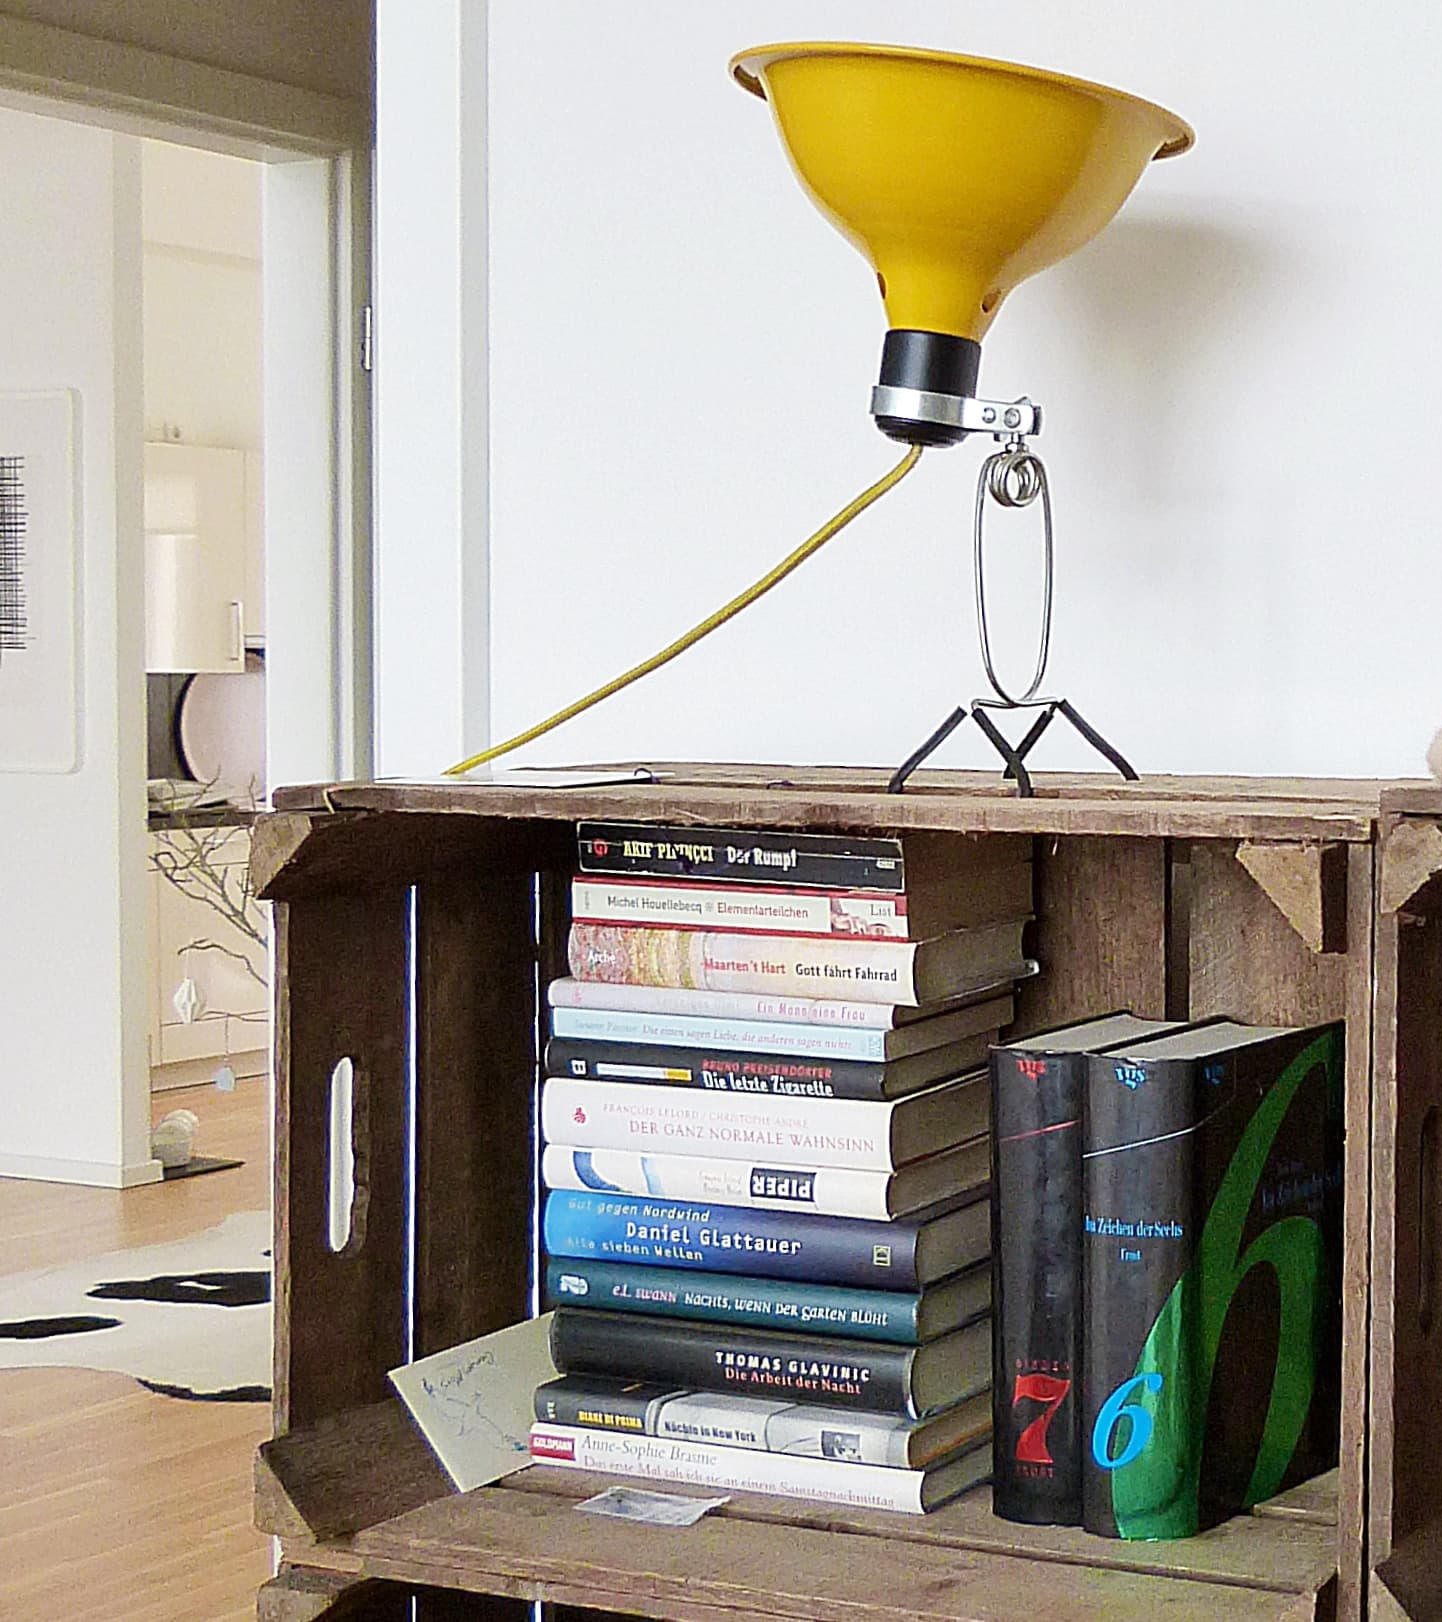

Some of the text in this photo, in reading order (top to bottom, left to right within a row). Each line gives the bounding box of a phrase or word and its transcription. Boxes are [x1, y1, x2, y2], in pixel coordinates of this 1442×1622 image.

[727, 845, 749, 863] Der
[754, 848, 797, 871] Rumpf
[608, 896, 639, 909] Michel
[642, 897, 702, 915] Houellebecq
[717, 902, 809, 919] Elementarteilchen
[871, 904, 891, 917] List
[704, 958, 897, 982] Maarten Hart Gott fährt Fahrrad
[703, 1069, 834, 1097] Die letzte Zigarette
[1115, 1066, 1146, 1090] vgs
[629, 1120, 875, 1152] DER GANZ NORMALE WAHNSINN
[752, 1175, 812, 1198] PIPER
[597, 1202, 638, 1218] gegen
[643, 1205, 711, 1223] Nordwind
[627, 1222, 802, 1256] Daniel Glattauer
[1097, 1217, 1134, 1237] Zeichen
[1136, 1219, 1153, 1237] der
[1153, 1220, 1183, 1238] Sechs
[602, 1240, 650, 1256] sieben
[655, 1243, 703, 1261] Wellen
[715, 1351, 871, 1383] THOMAS GLAVINIC
[725, 1367, 862, 1395] Die Arbeit der Nacht
[1012, 1373, 1071, 1464] 7
[1091, 1372, 1164, 1471] 6
[712, 1425, 735, 1440] New
[736, 1428, 756, 1444] York
